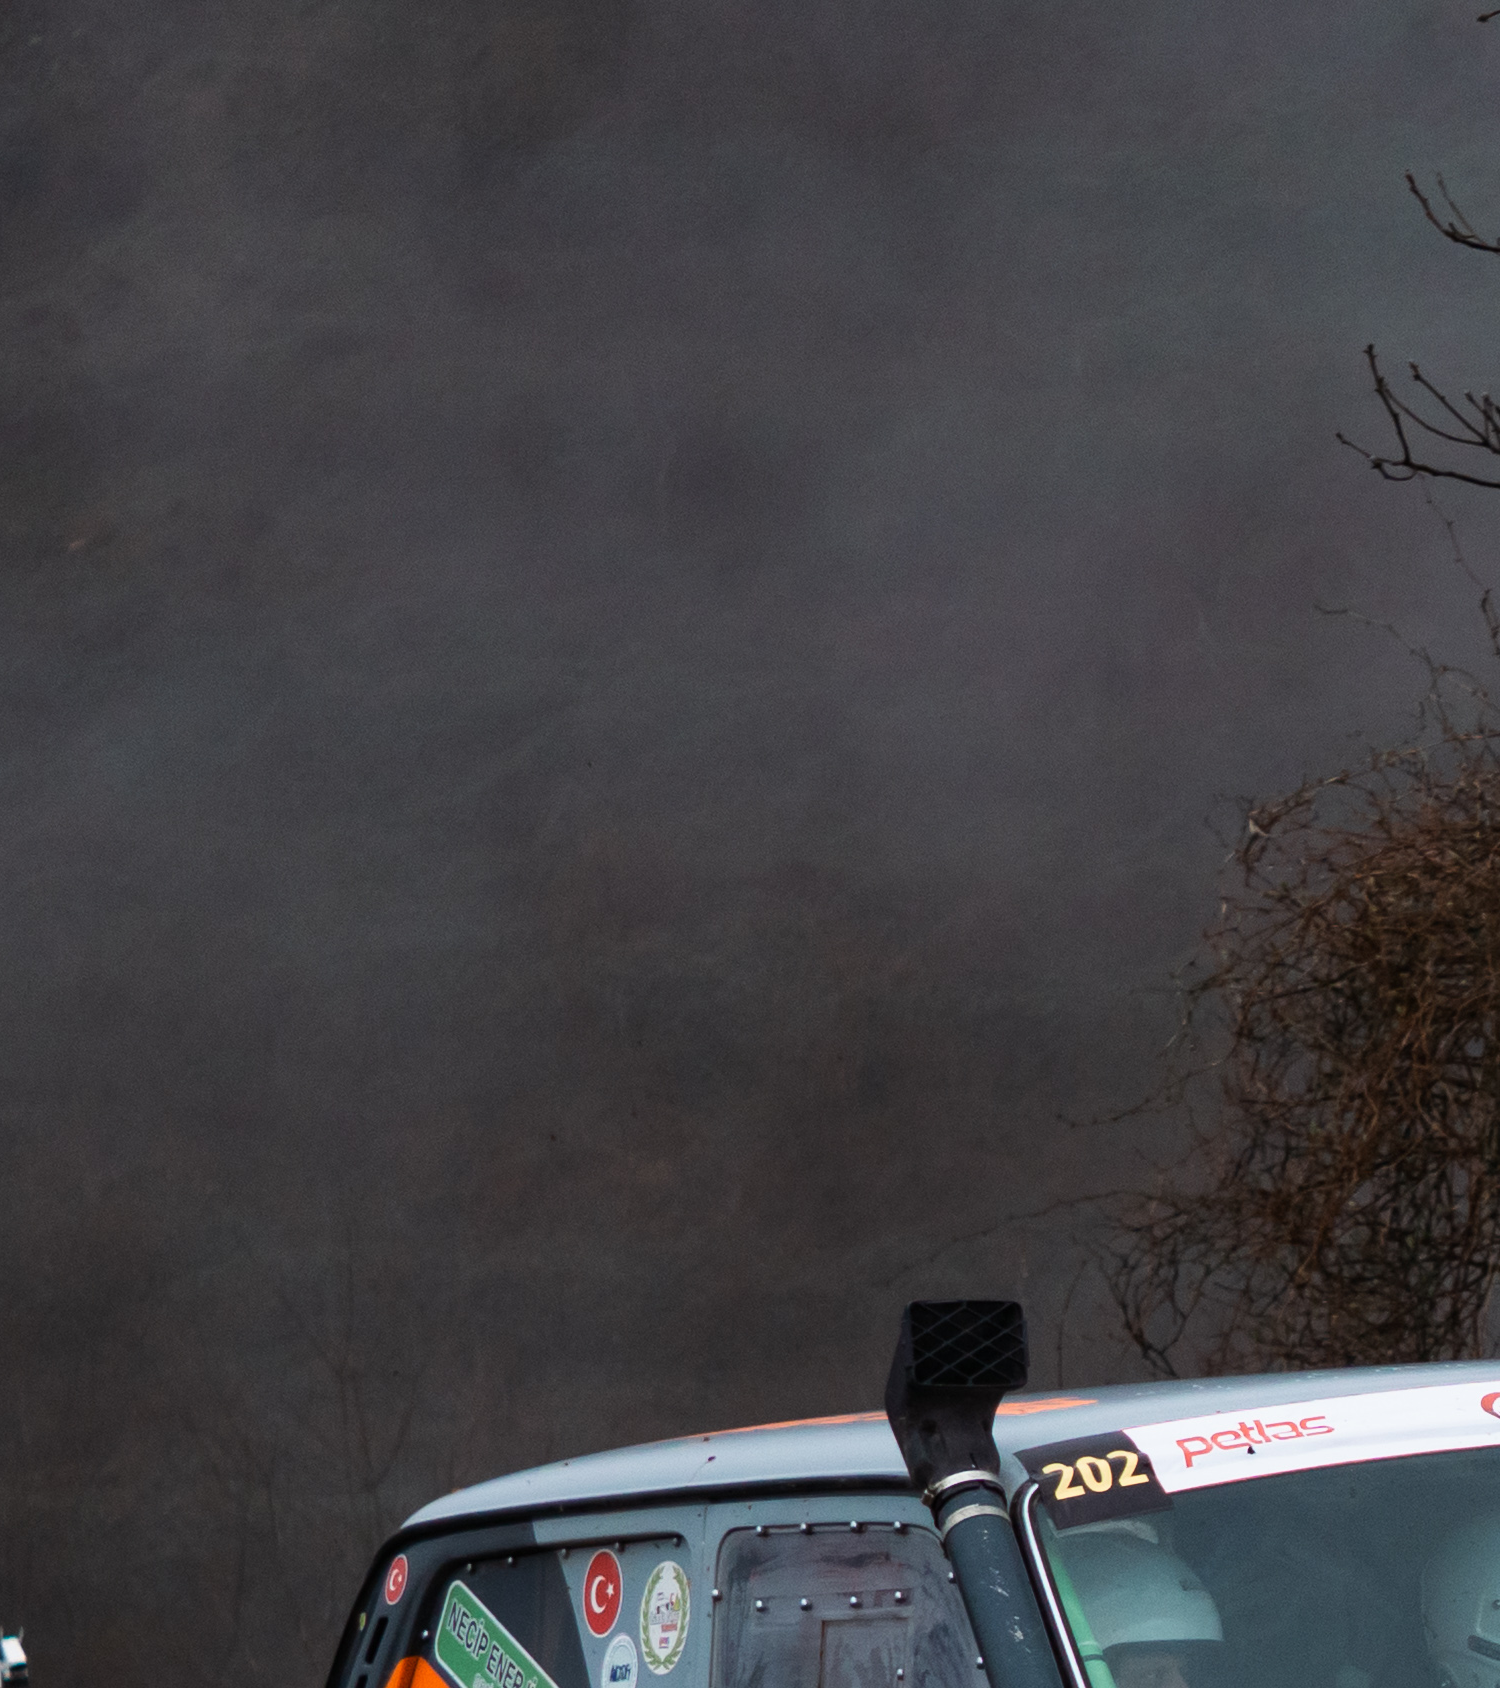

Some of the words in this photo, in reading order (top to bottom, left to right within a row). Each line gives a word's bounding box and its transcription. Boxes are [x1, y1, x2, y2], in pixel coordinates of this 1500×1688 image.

[1175, 1416, 1335, 1468] petlas
[1042, 1450, 1150, 1500] 202
[447, 1599, 489, 1661] NECİP
